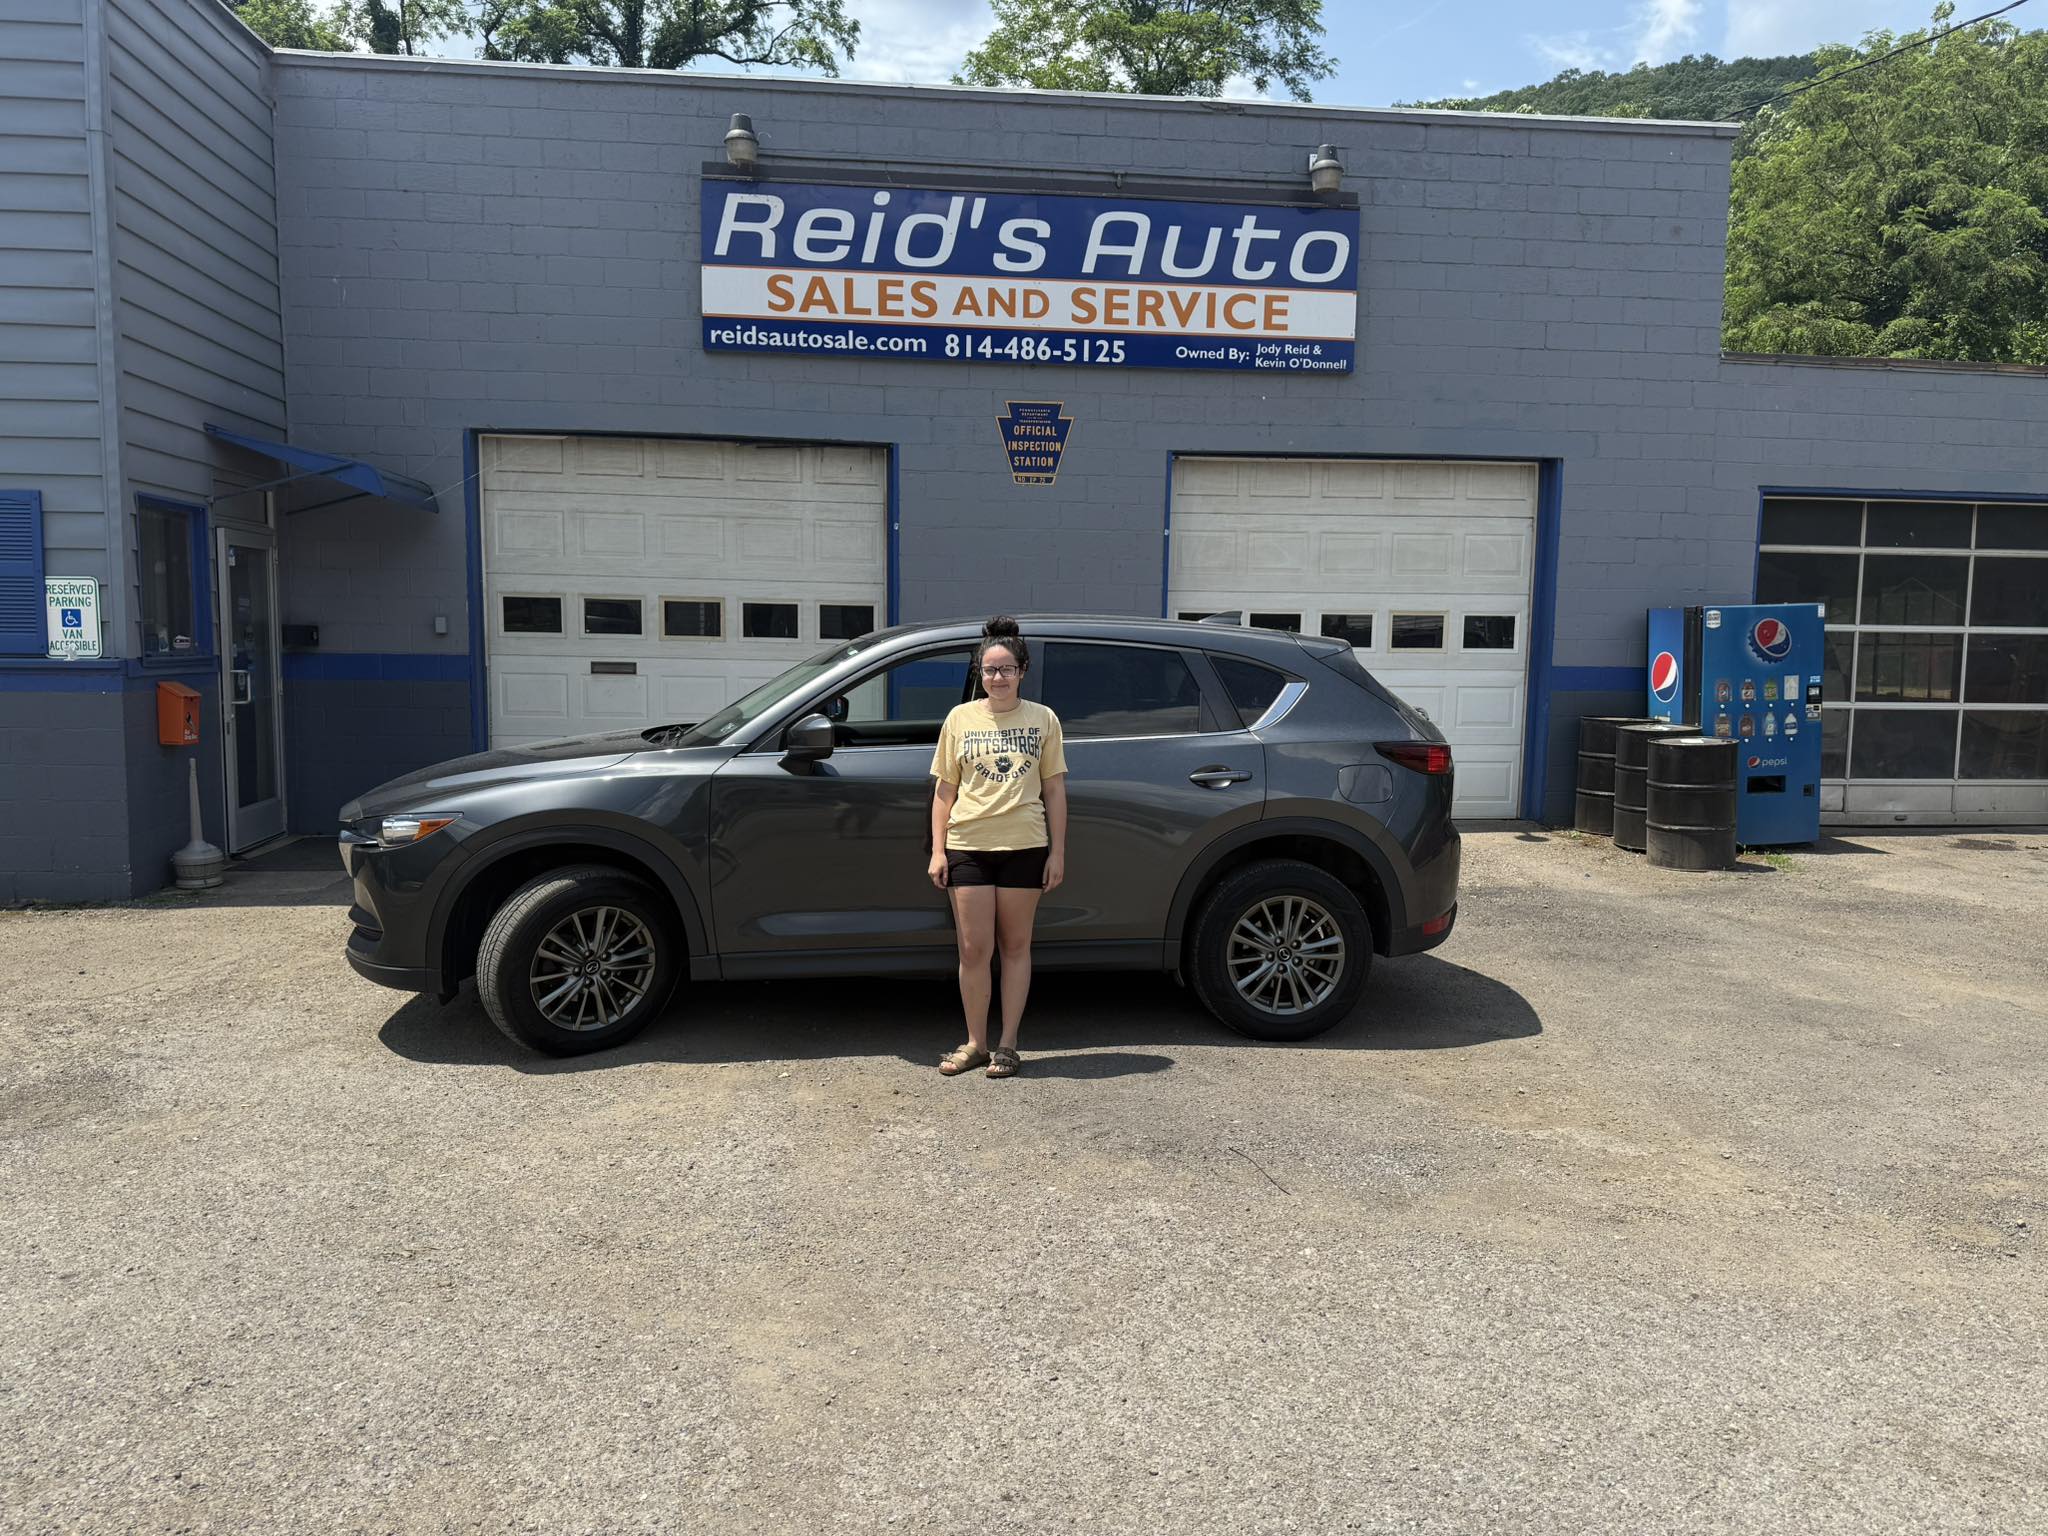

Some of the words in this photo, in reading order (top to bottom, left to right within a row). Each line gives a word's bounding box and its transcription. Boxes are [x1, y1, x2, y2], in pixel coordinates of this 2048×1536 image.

[714, 191, 1051, 272] Reid's
[1081, 211, 1350, 283] Auto
[766, 274, 938, 318] SALES
[952, 286, 1050, 319] AND
[1071, 287, 1289, 331] SERVICE
[710, 325, 927, 353] reidsautosale.com
[944, 334, 1126, 364] 814-486-5125
[1255, 344, 1281, 356] Jody
[1285, 344, 1310, 356] Reid
[1312, 346, 1322, 356] &
[1175, 346, 1224, 360] Owned
[1229, 348, 1250, 363] By:
[1255, 357, 1286, 368] Kevin
[1289, 358, 1347, 370] O'Donnell
[1013, 425, 1057, 436] OFFICIAL
[1008, 441, 1062, 452] INSPECTION
[1013, 456, 1054, 467] STATION
[46, 584, 94, 595] RESERVED
[49, 596, 92, 607] PARKING
[62, 629, 83, 639] VAN
[964, 727, 1024, 738] UNIVERSITY
[1028, 727, 1040, 736] OF
[963, 735, 1041, 763] PITTSBURGH
[1761, 756, 1787, 767] pepsi
[974, 759, 1032, 782] BRADFORD
